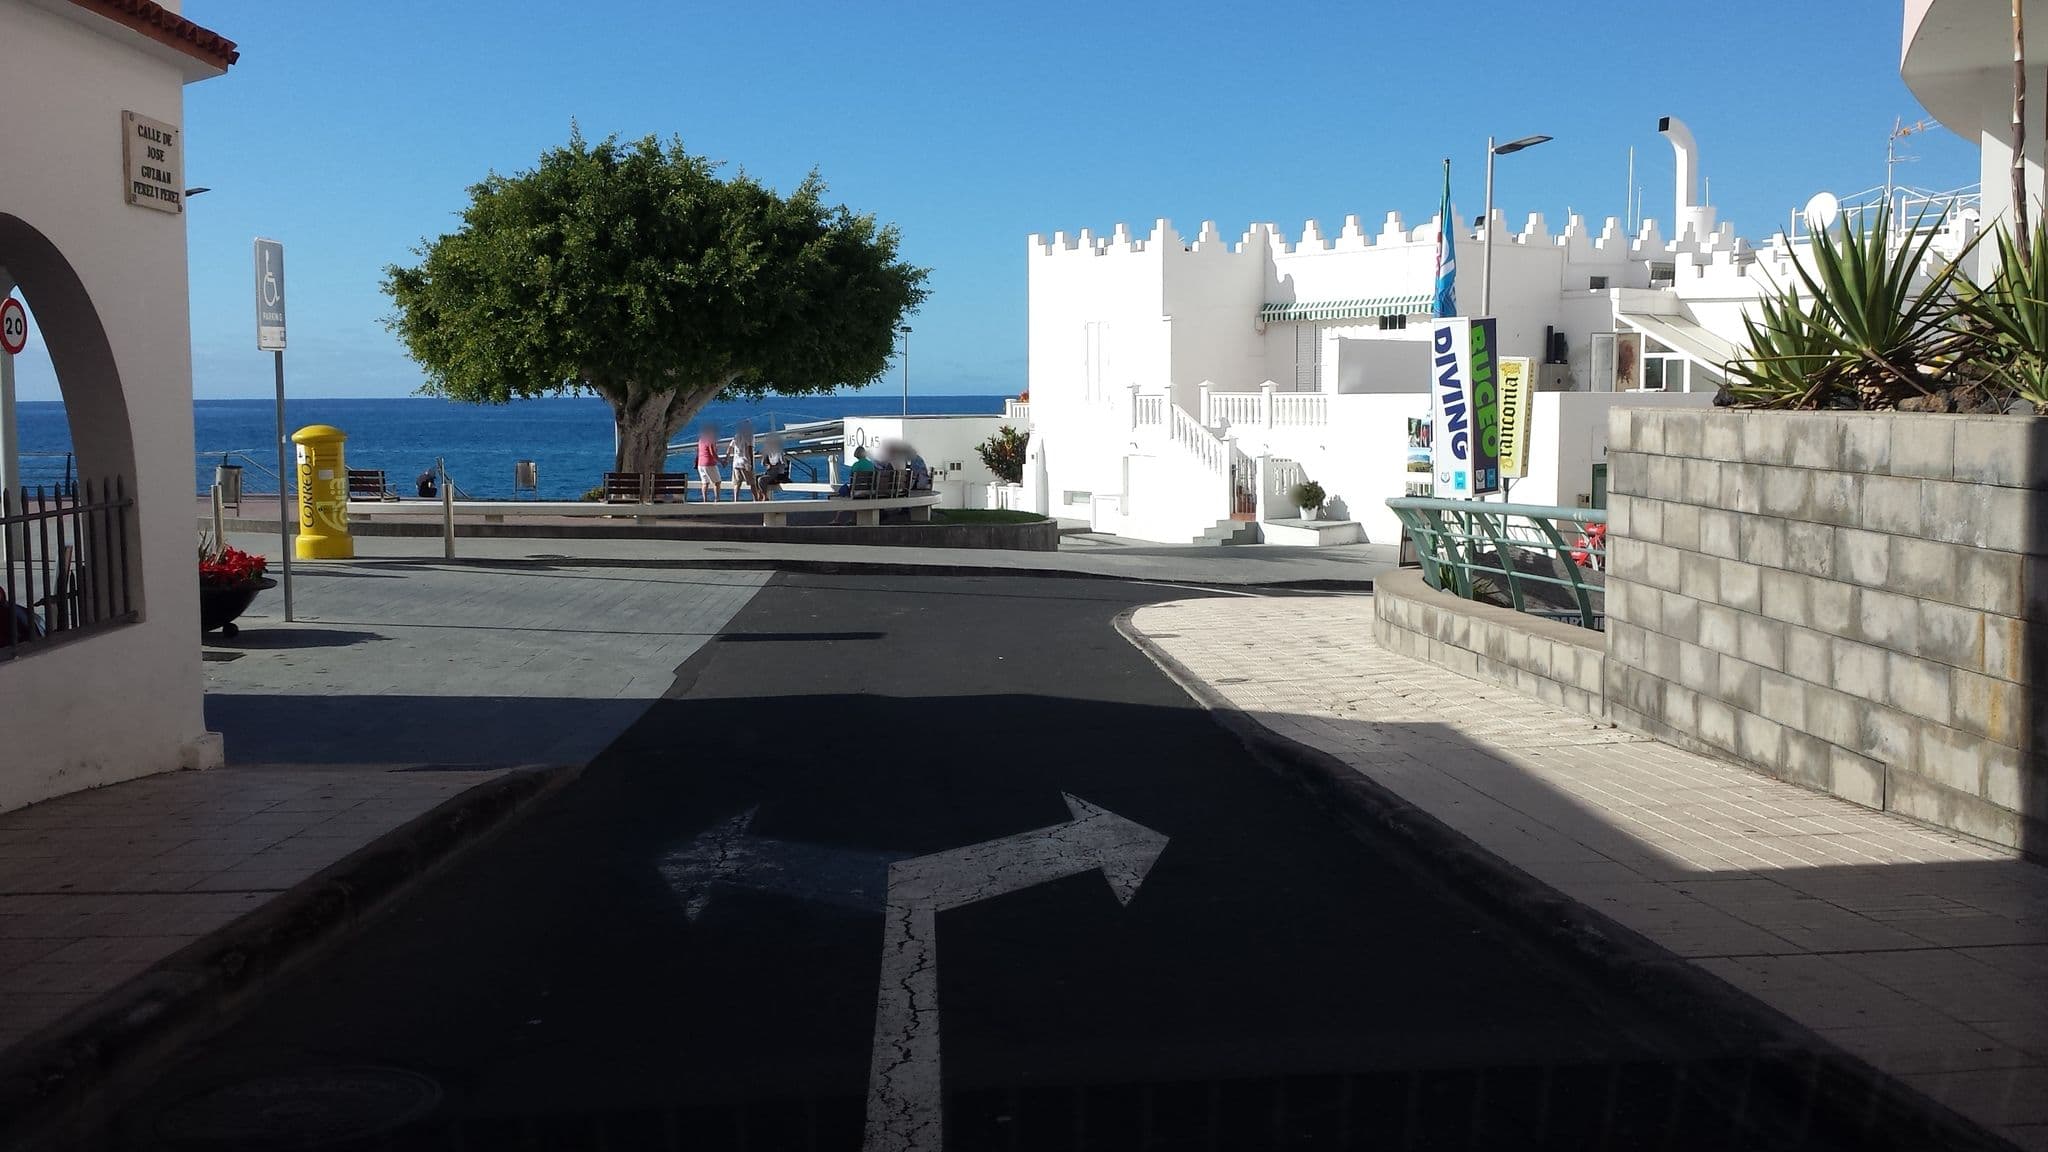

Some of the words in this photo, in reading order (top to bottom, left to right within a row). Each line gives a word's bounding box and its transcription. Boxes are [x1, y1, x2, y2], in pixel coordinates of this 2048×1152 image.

[138, 125, 161, 143] CALLE
[162, 133, 173, 146] DE
[147, 145, 165, 162] JOSE
[141, 165, 172, 184] GUZMAN
[133, 181, 154, 198] PEREZ
[154, 187, 160, 199] Y
[160, 188, 180, 204] PEREZ
[6, 317, 23, 335] 20
[262, 311, 283, 321] PARKING
[1435, 326, 1468, 460] DIVING
[1471, 325, 1498, 458] BUCEO
